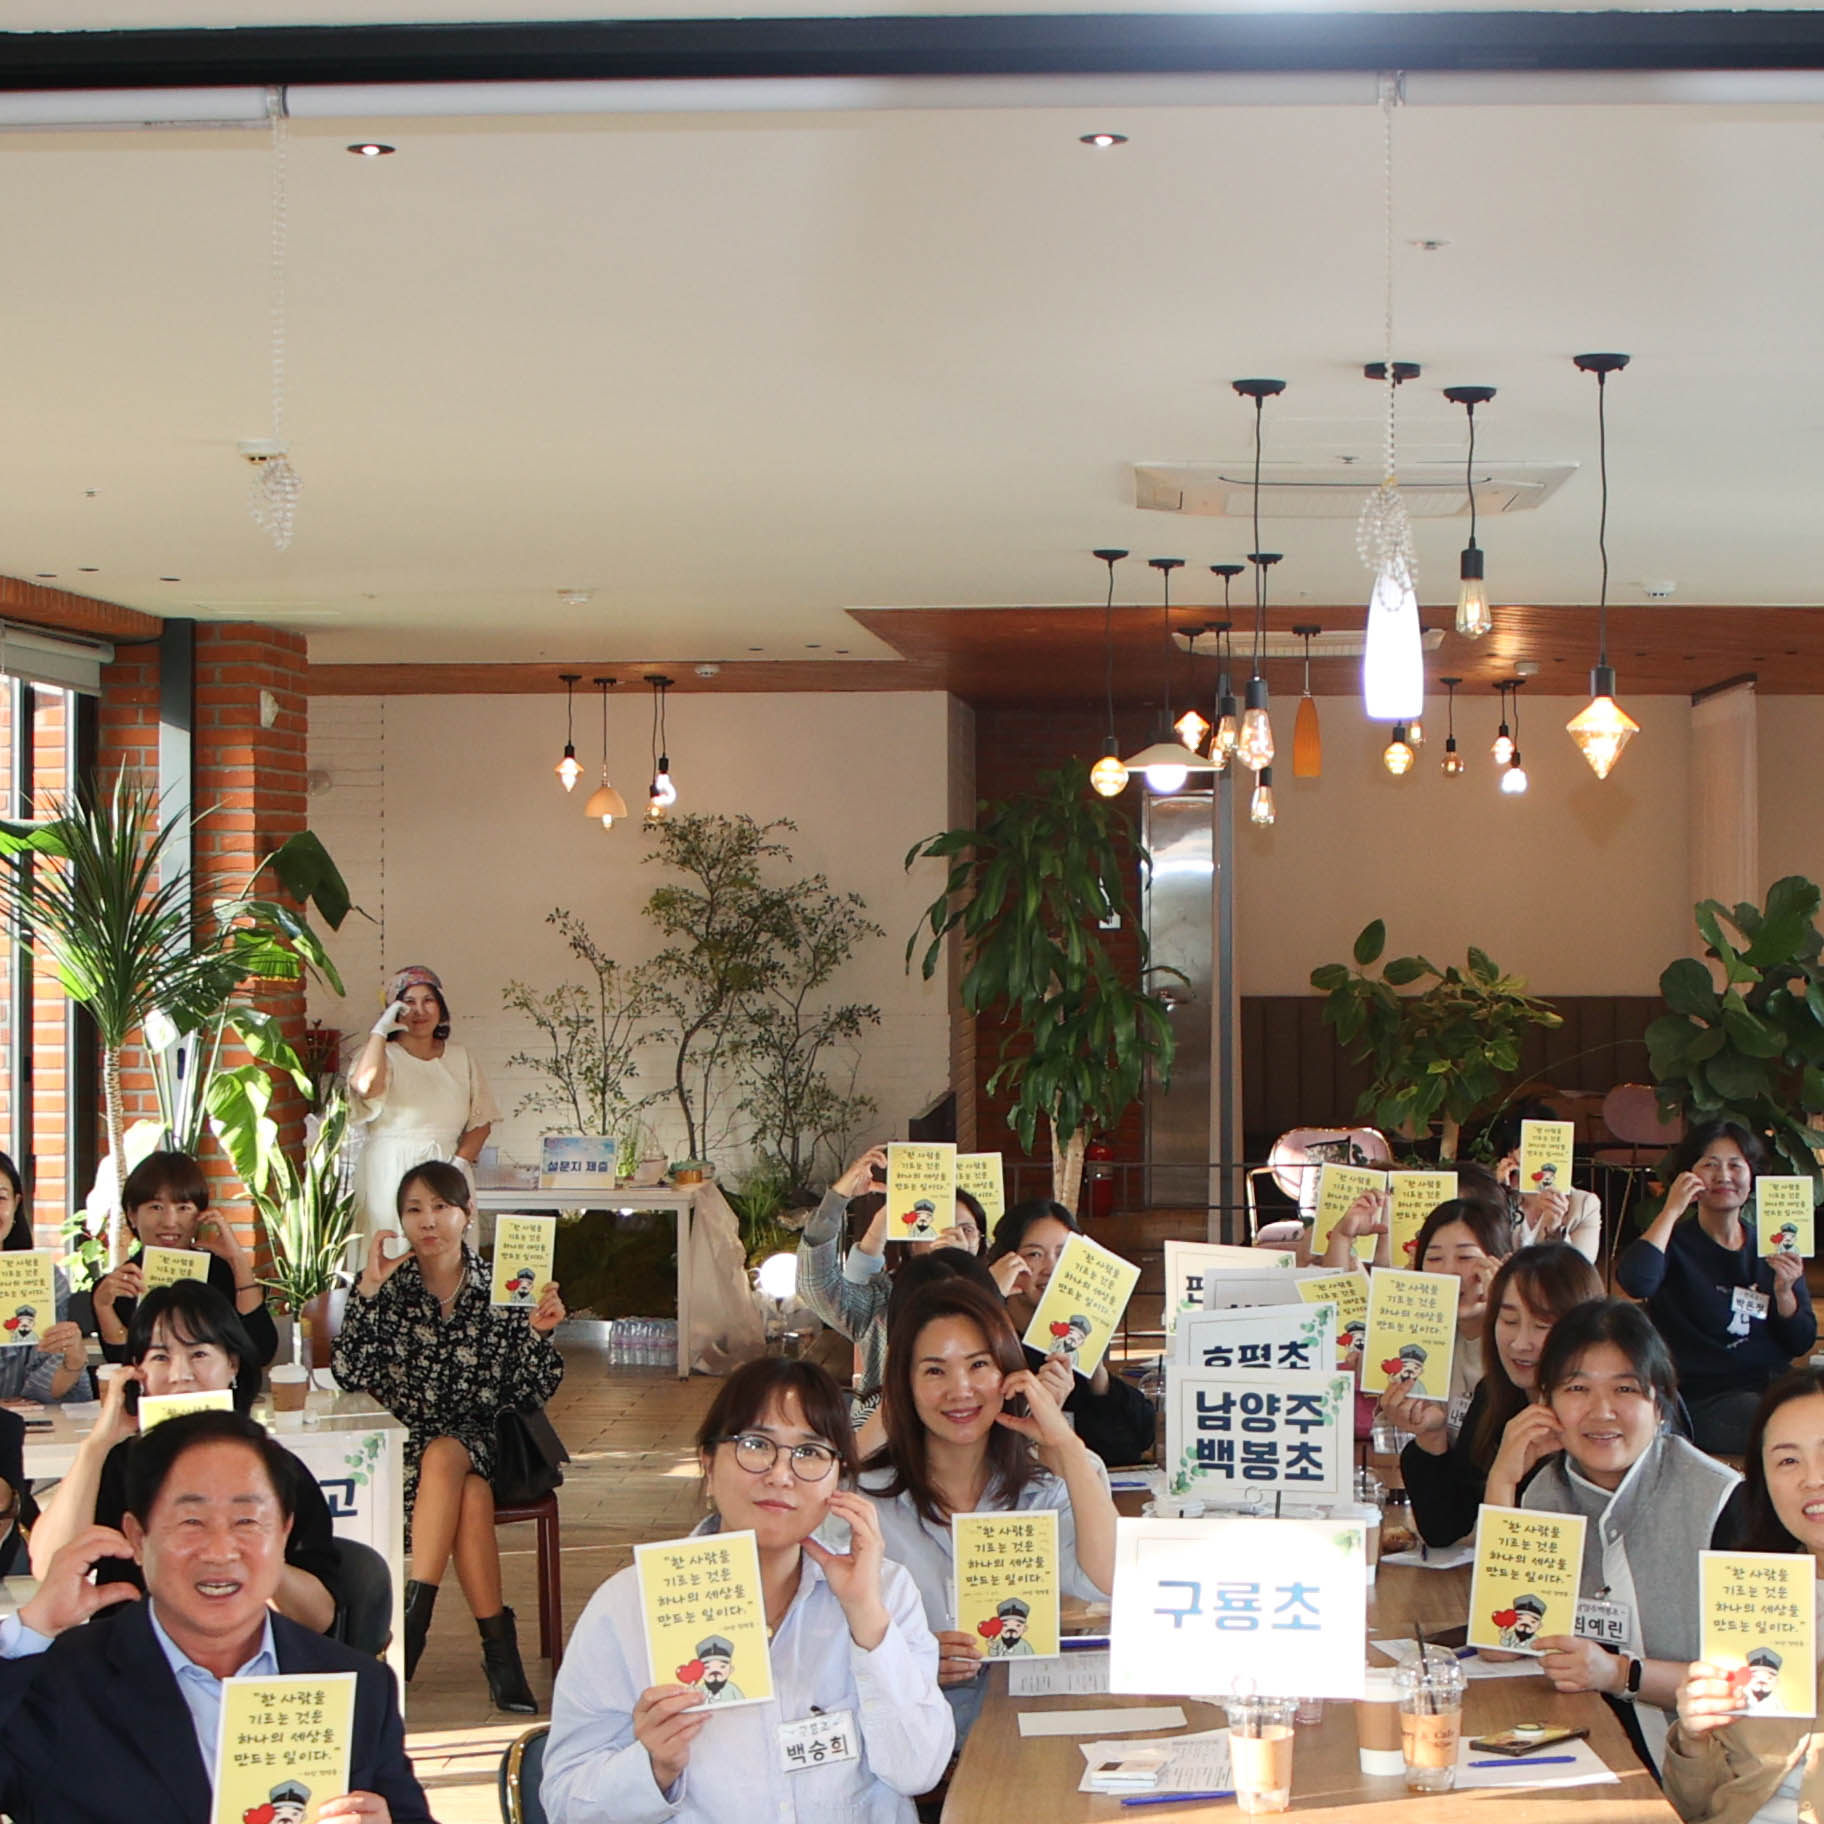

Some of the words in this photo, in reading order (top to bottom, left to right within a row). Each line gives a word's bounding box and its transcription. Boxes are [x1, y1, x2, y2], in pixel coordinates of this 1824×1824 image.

[548, 1160, 582, 1173] 설문지
[586, 1160, 609, 1173] 제출
[1195, 1389, 1325, 1434] 남양주
[1196, 1437, 1325, 1482] 백봉초
[998, 1523, 1034, 1537] 사람을
[1523, 1524, 1560, 1539] 사람을
[974, 1542, 1007, 1554] 기르는
[1011, 1540, 1034, 1553] 것은
[1498, 1537, 1530, 1550] 기르는
[1536, 1541, 1558, 1554] 것은
[689, 1548, 730, 1565] 사람을
[967, 1558, 1004, 1569] 하나의
[1009, 1555, 1044, 1569] 세상을
[1489, 1550, 1526, 1564] 하나의
[1531, 1557, 1567, 1571] 세상을
[663, 1573, 700, 1587] 기르는
[705, 1567, 731, 1584] 것은
[966, 1574, 999, 1587] 만드는
[1485, 1566, 1519, 1580] 만드는
[1749, 1568, 1789, 1582] 사람을
[657, 1591, 699, 1607] 하나의
[705, 1583, 746, 1600] 세상을
[1723, 1585, 1758, 1598] 기르는
[1763, 1585, 1787, 1599] 것은
[1153, 1577, 1322, 1631] 구룡초
[1715, 1601, 1755, 1613] 하나의
[1760, 1603, 1799, 1618] 세상을
[657, 1610, 695, 1627] 만드는
[1713, 1619, 1749, 1632] 만드는
[280, 1689, 325, 1705] 사람을
[249, 1712, 289, 1726] 기르는
[295, 1709, 322, 1725] 것은
[238, 1732, 284, 1745] 하나의
[290, 1727, 334, 1744] 세상을
[786, 1733, 848, 1764] 백승희
[233, 1751, 275, 1767] 만드는
